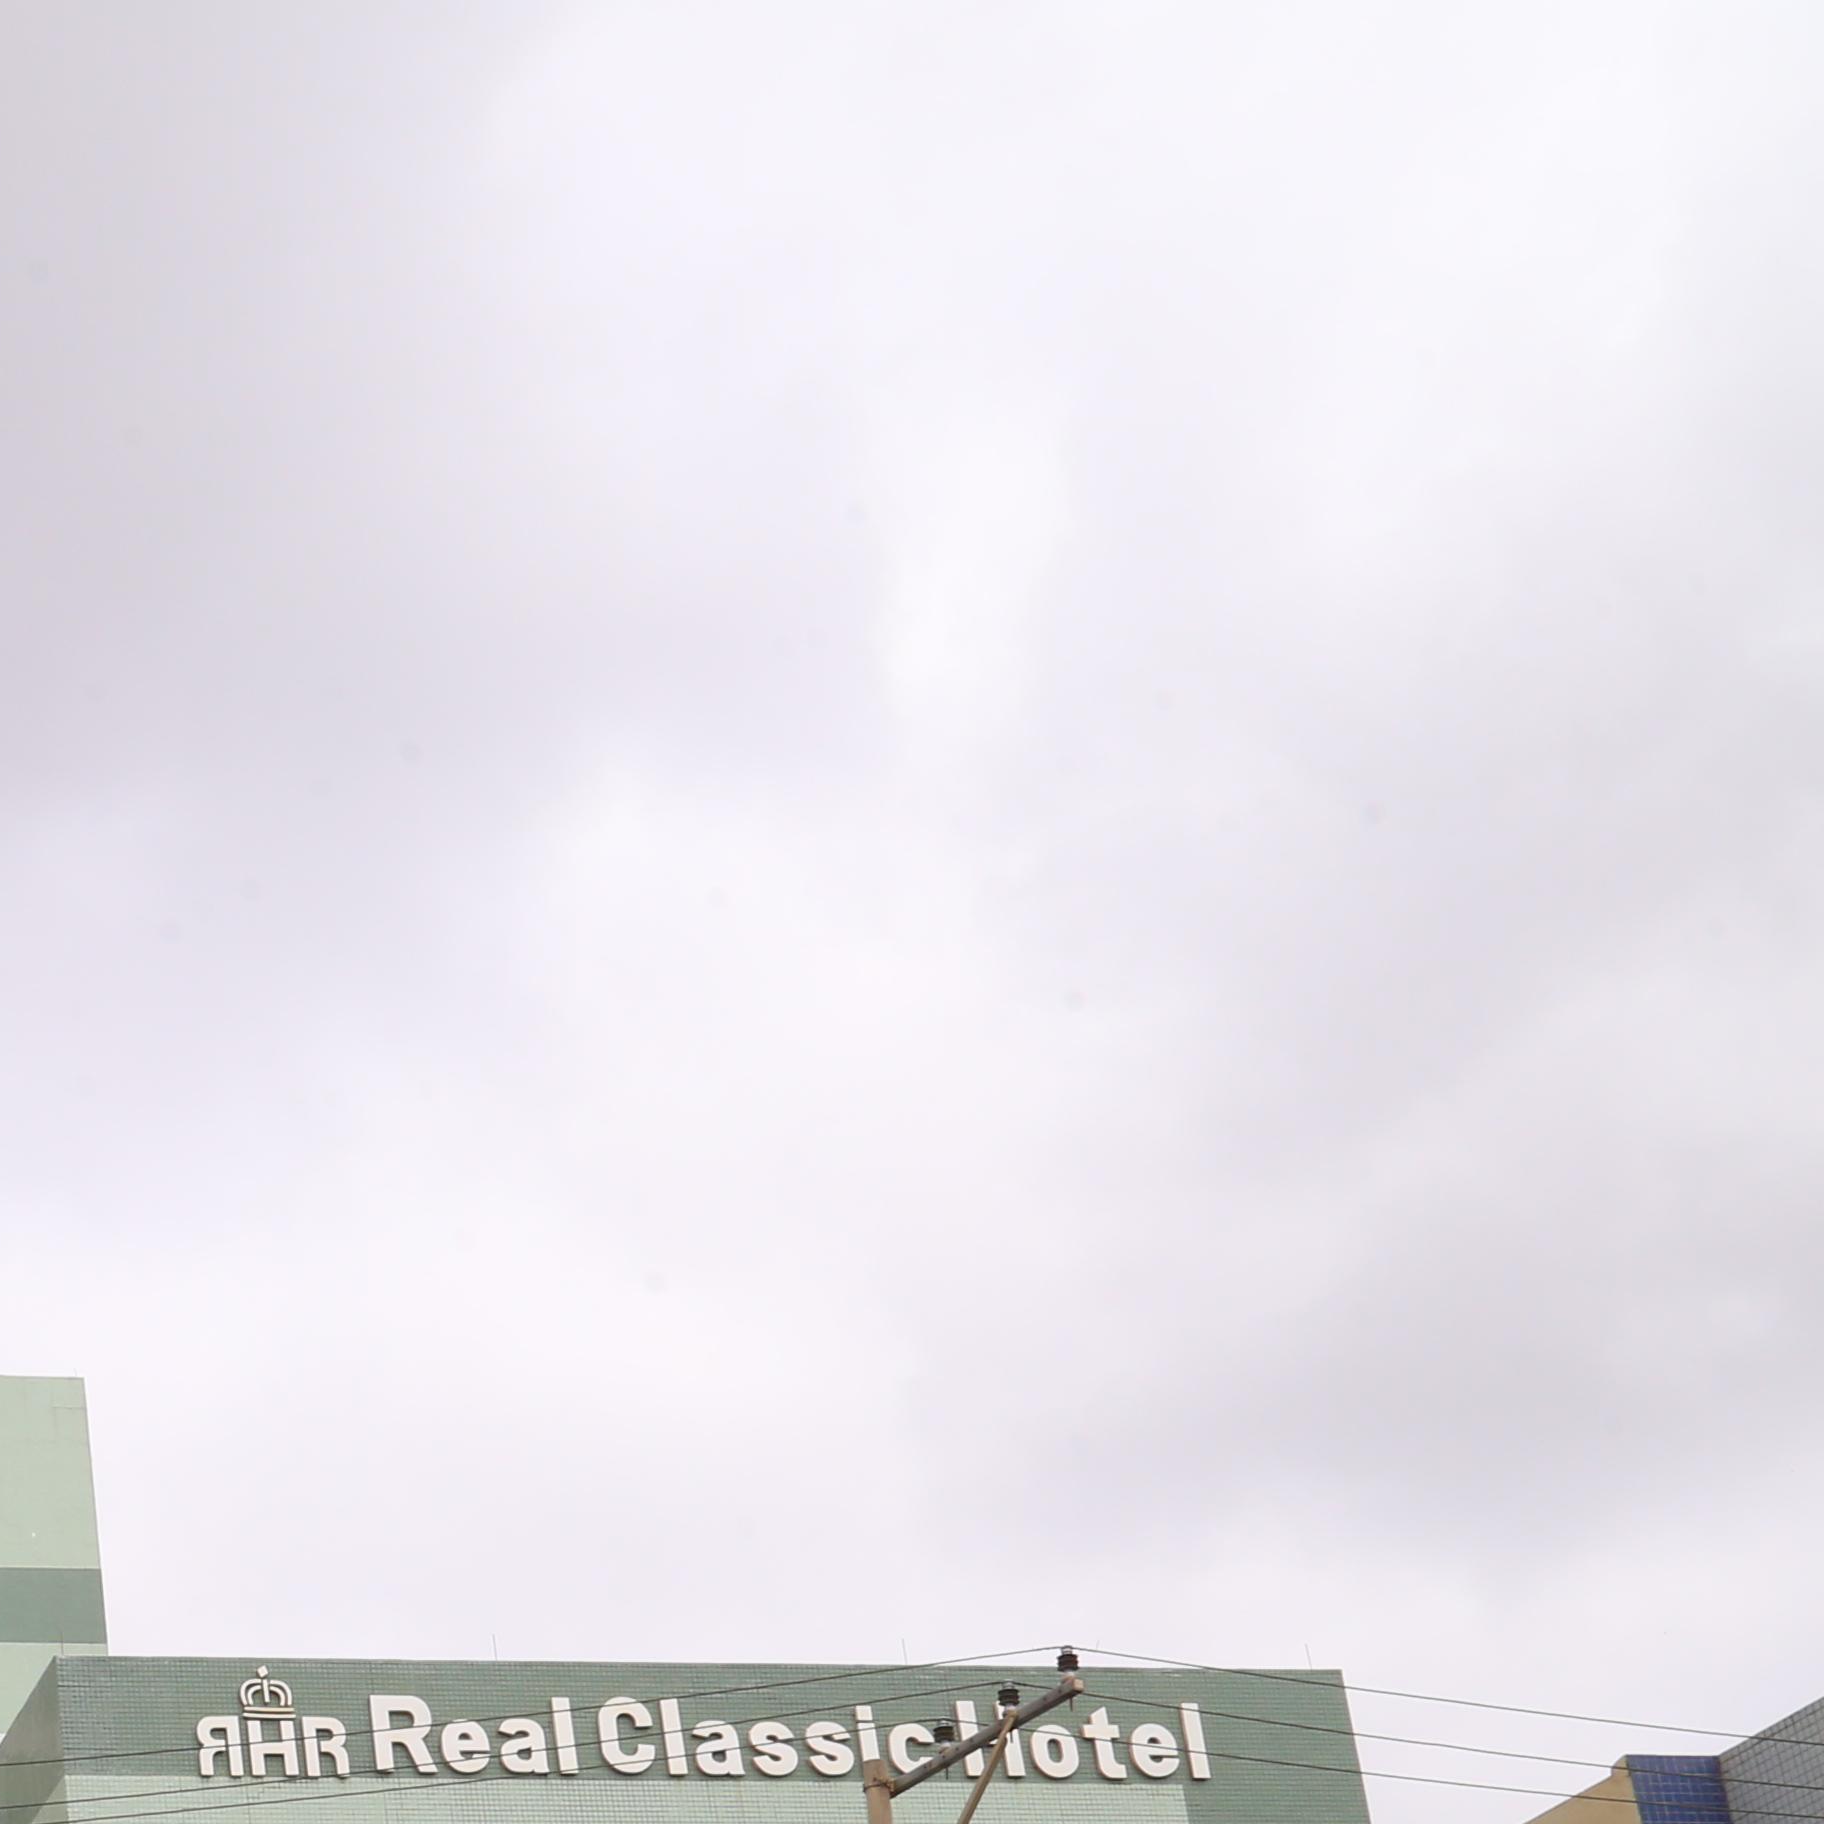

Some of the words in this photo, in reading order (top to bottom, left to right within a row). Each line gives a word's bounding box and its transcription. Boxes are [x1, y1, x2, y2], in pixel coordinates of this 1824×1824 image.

[369, 1694, 580, 1776] Real
[598, 1696, 940, 1777] Classic
[955, 1699, 1212, 1780] Hotel
